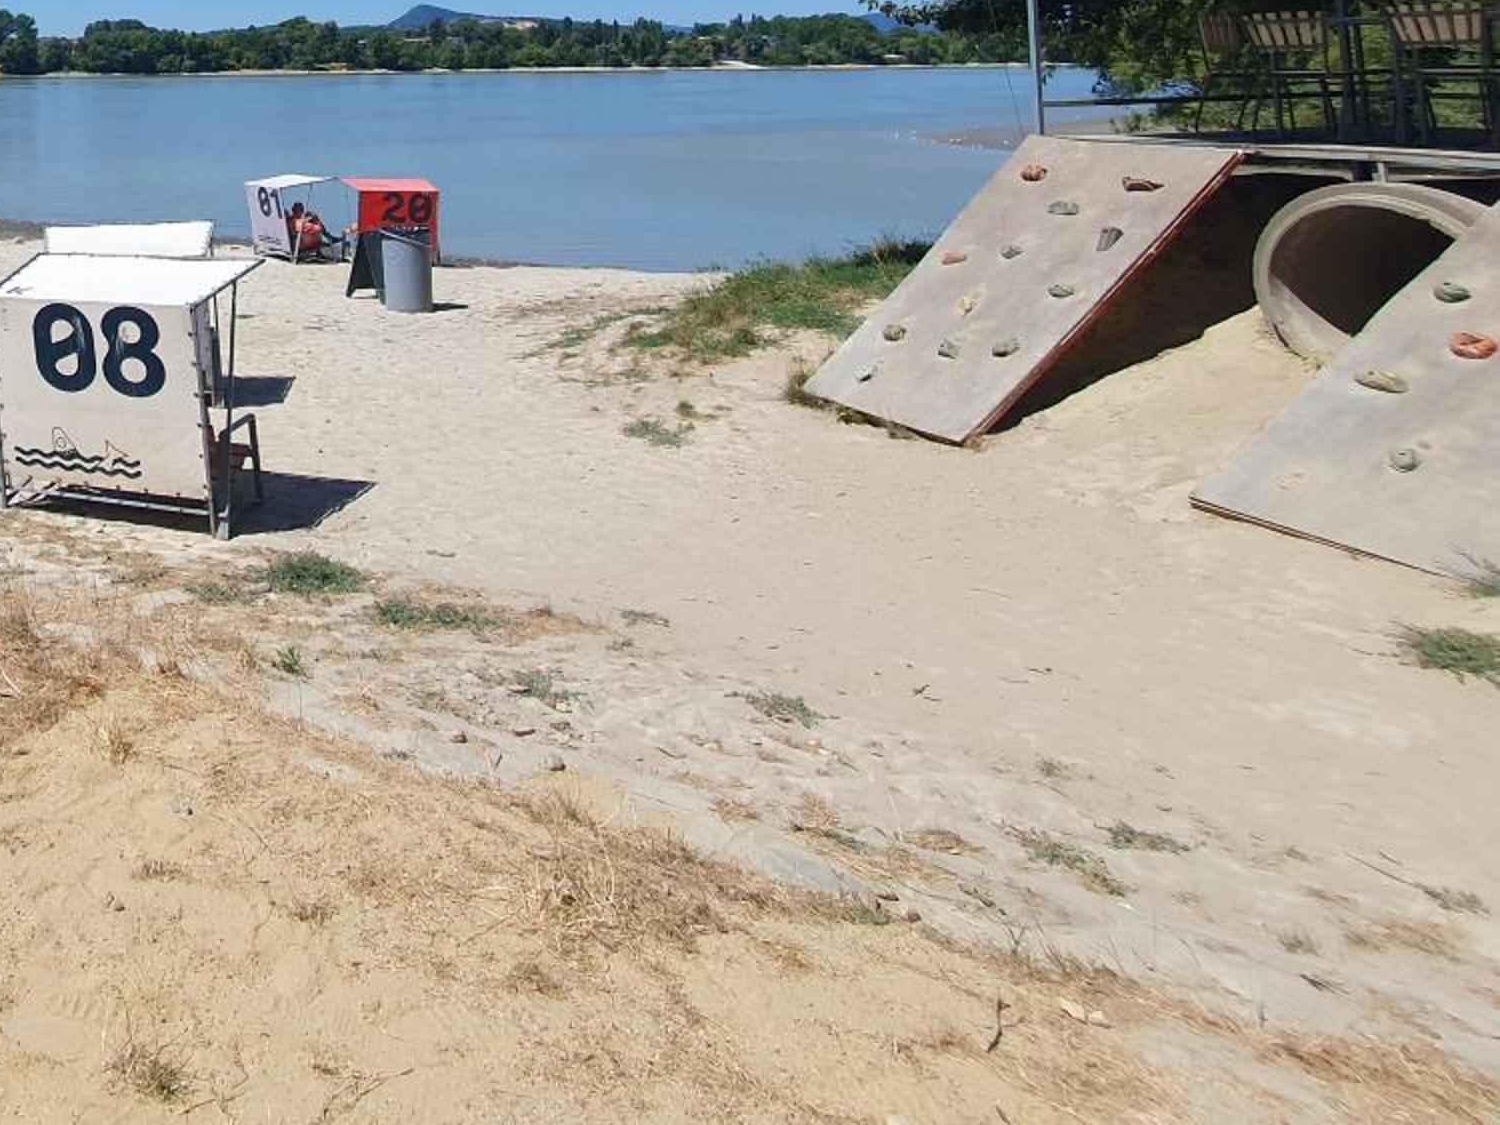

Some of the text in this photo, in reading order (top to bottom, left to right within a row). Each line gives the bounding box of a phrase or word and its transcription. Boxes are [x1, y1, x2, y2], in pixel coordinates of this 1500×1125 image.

[258, 187, 282, 219] 01
[382, 191, 431, 223] 20
[32, 302, 166, 397] 08
